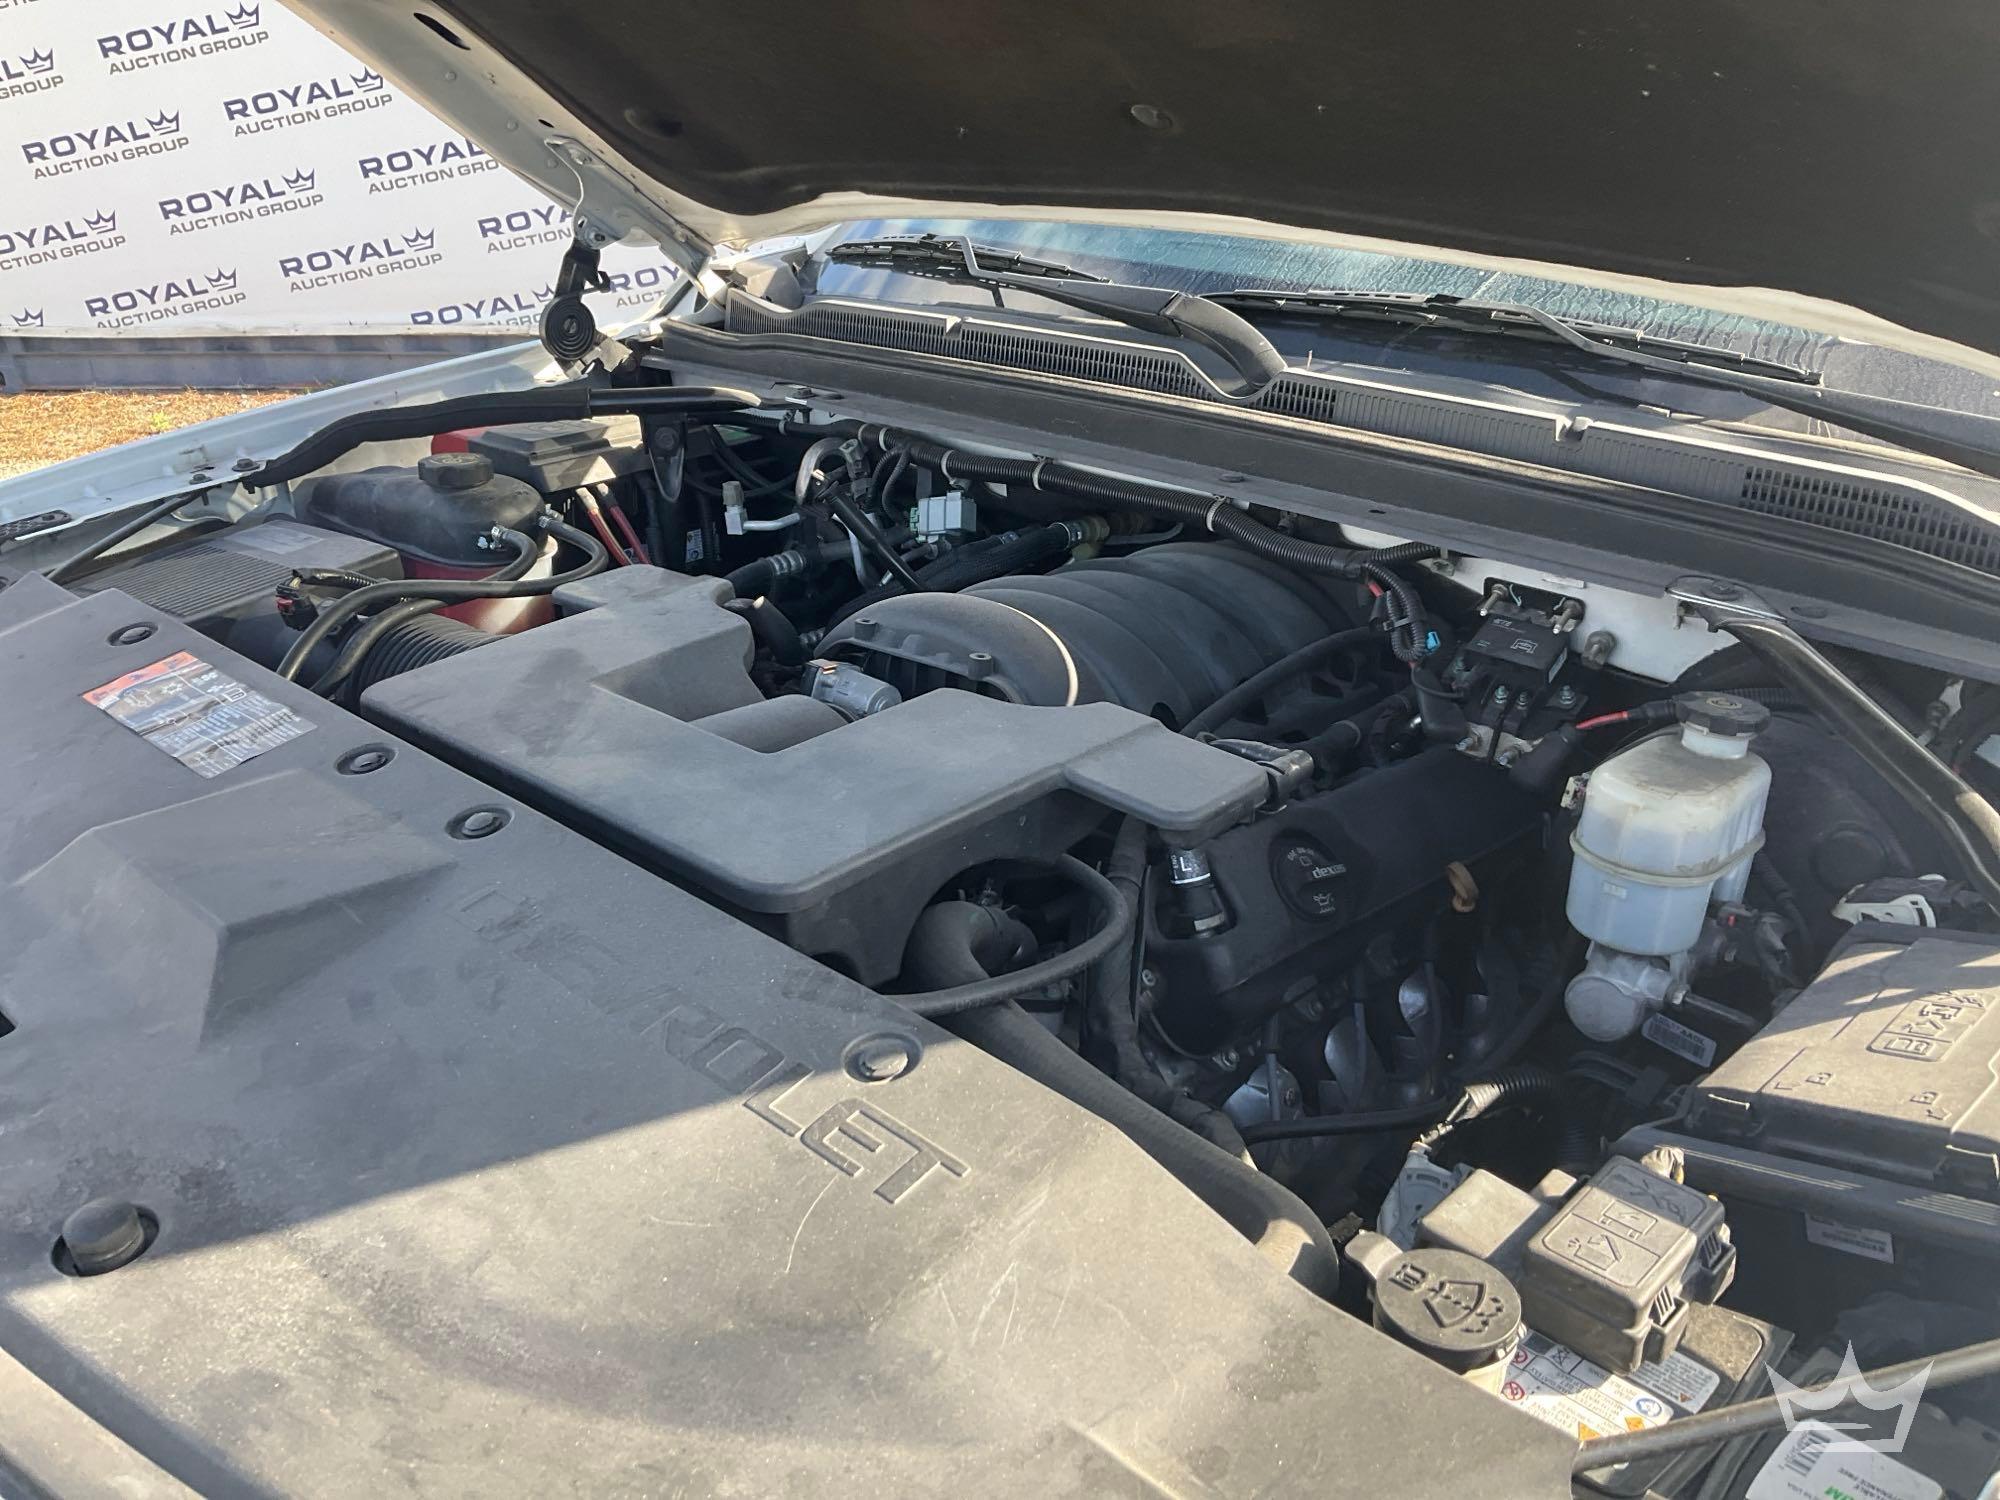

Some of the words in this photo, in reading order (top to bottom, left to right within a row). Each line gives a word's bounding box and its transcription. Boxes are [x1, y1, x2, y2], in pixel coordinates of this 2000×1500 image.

[97, 14, 229, 58] ROYAL
[109, 46, 197, 75] AUCTION
[199, 30, 270, 56] GROUP
[223, 78, 354, 120] ROYAL
[234, 109, 320, 137] AUCTION
[323, 94, 393, 118] GROUP
[21, 121, 151, 164] ROYAL
[34, 152, 119, 180] AUCTION
[122, 136, 190, 161] GROUP
[358, 138, 485, 179] ROYAL
[368, 167, 454, 194] AUCTION
[457, 159, 499, 176] GRO
[158, 179, 286, 220] ROYAL
[169, 208, 254, 236] AUCTION
[257, 194, 324, 218] GROUP
[0, 220, 88, 255] OYAL
[0, 249, 58, 270] CTION
[60, 235, 126, 258] GROUP
[487, 227, 572, 253] AUCTION
[279, 238, 405, 278] ROYAL
[290, 266, 373, 293] AUCTION
[376, 253, 443, 275] GROUP
[85, 278, 209, 317] ROYAL
[609, 265, 681, 292] ROY
[97, 305, 178, 328] AUCTION
[181, 292, 247, 314] GROUP
[410, 293, 535, 325] ROYAL
[616, 290, 665, 308] AUCT
